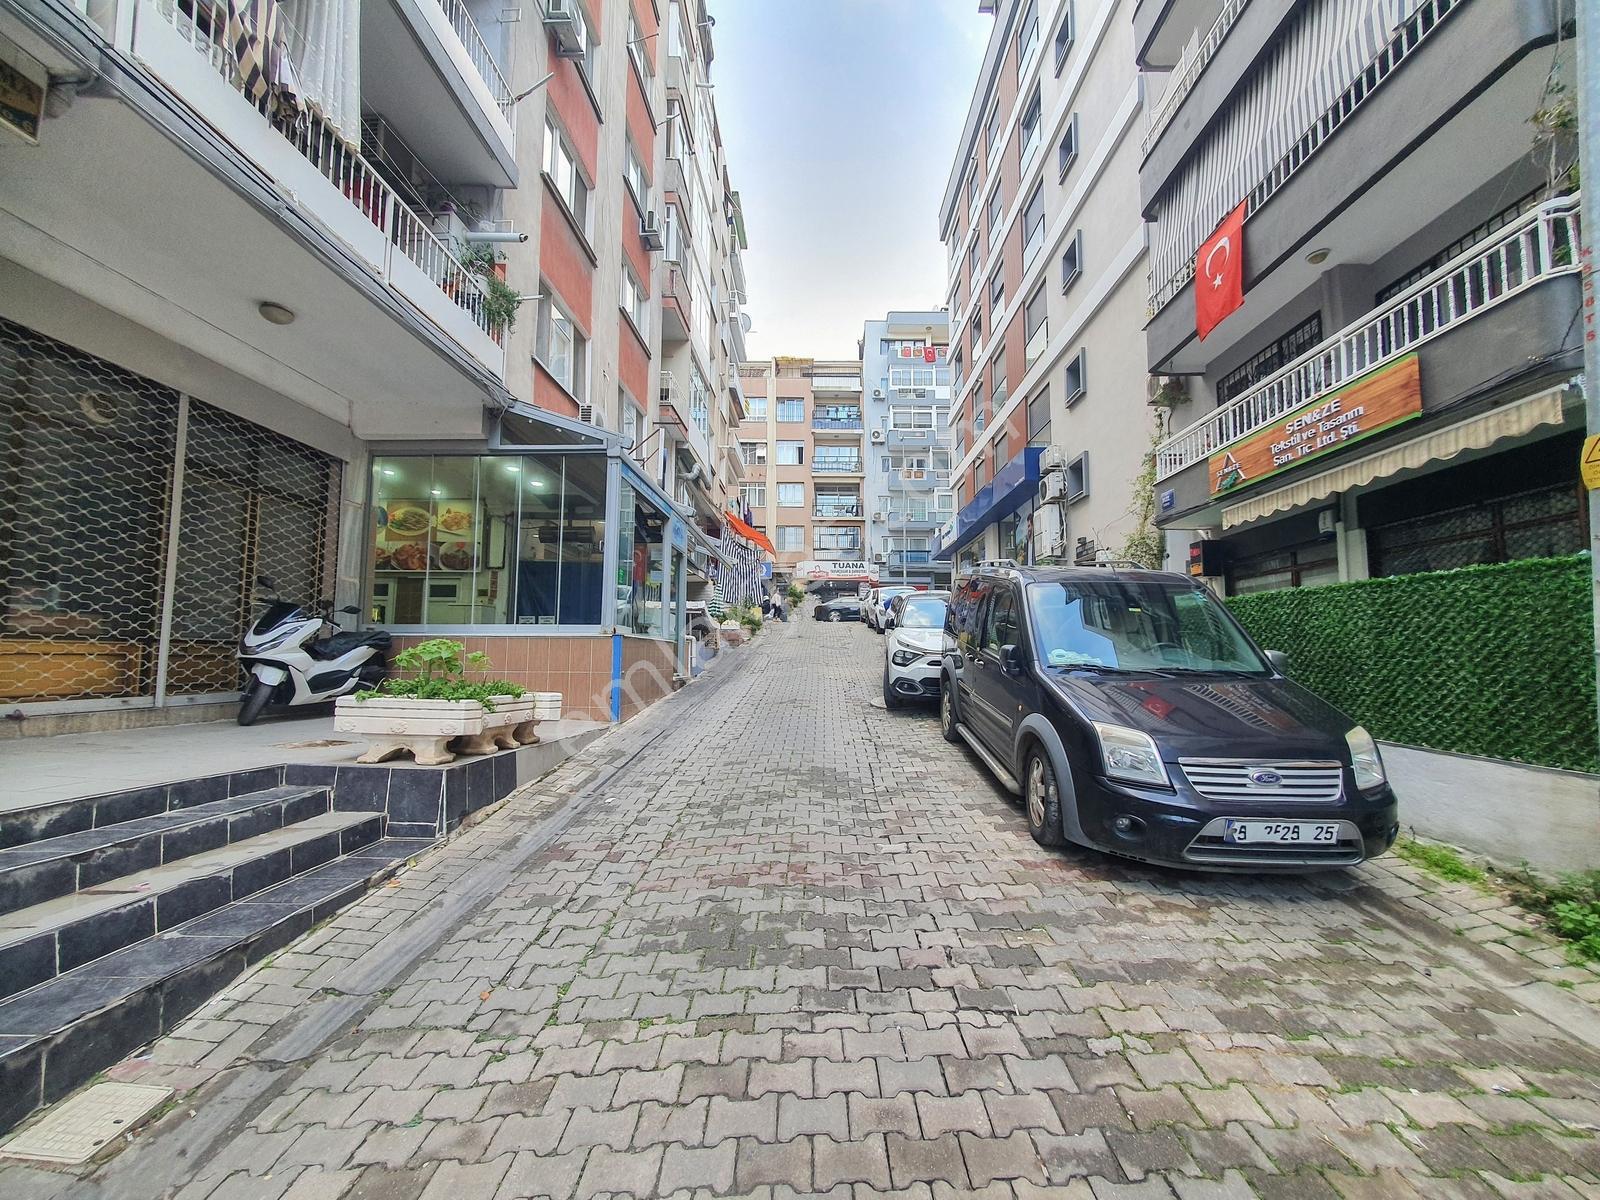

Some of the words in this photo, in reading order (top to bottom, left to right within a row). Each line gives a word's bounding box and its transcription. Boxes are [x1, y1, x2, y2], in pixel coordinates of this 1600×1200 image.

[1286, 399, 1341, 434] SEN&ZE
[1270, 433, 1301, 454] Tekstil
[1301, 428, 1317, 439] ve
[1273, 453, 1295, 466] San.
[1296, 443, 1315, 456] Tic.
[1316, 432, 1339, 448] Ltd.
